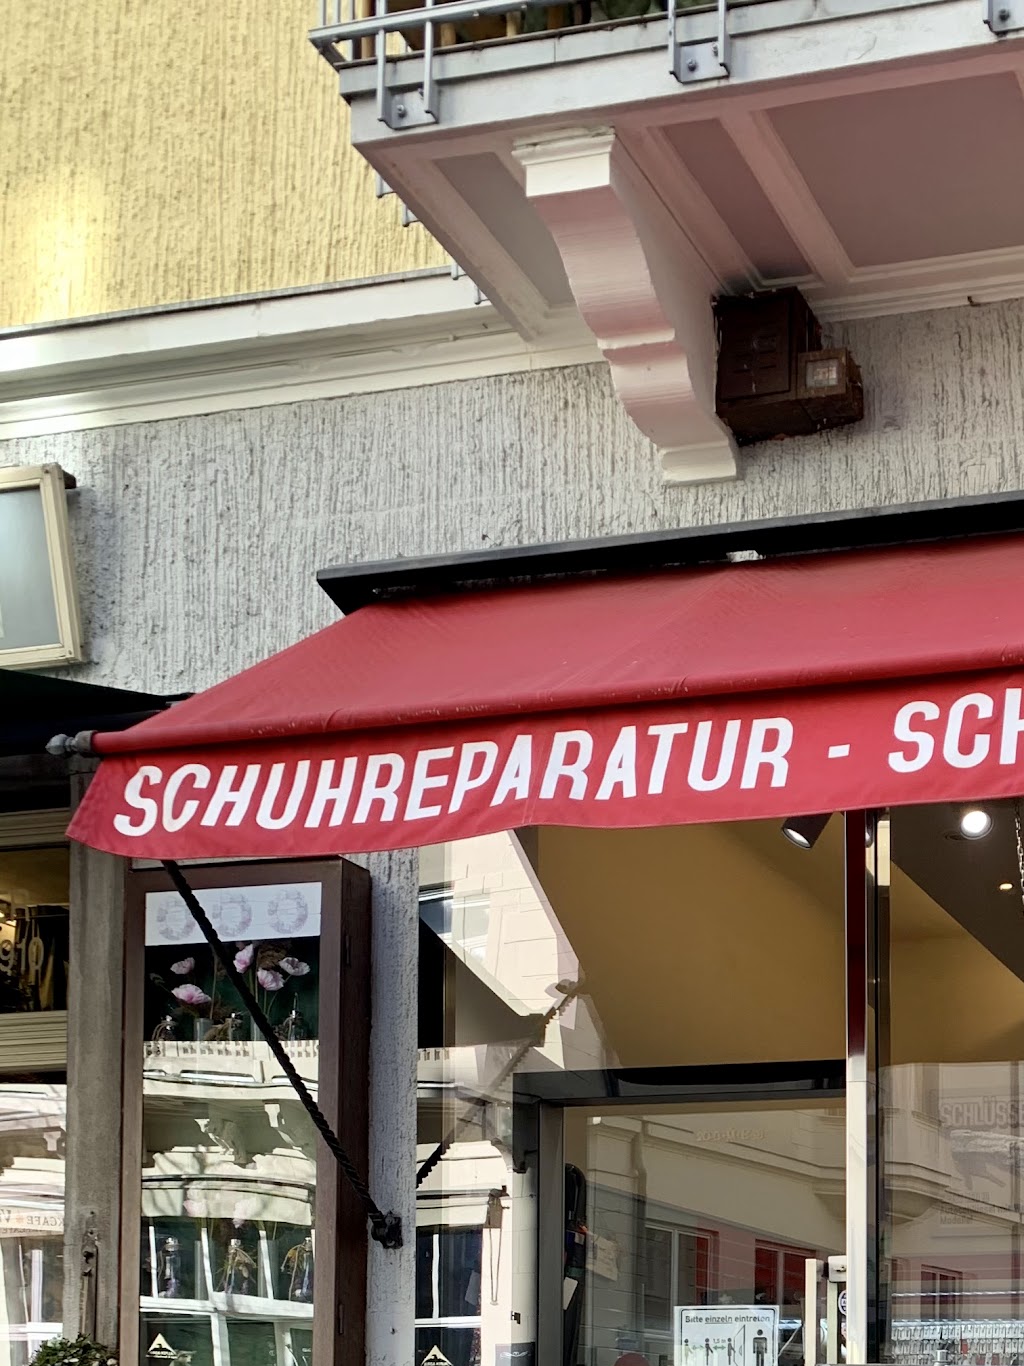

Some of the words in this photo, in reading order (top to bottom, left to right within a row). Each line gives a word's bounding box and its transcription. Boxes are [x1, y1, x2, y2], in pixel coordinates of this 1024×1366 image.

[113, 716, 794, 837] SCHUHREPARATUR
[828, 744, 850, 759] -
[685, 1315, 704, 1324] Bitte
[705, 1315, 733, 1324] einzeln
[734, 1315, 771, 1324] eintreten
